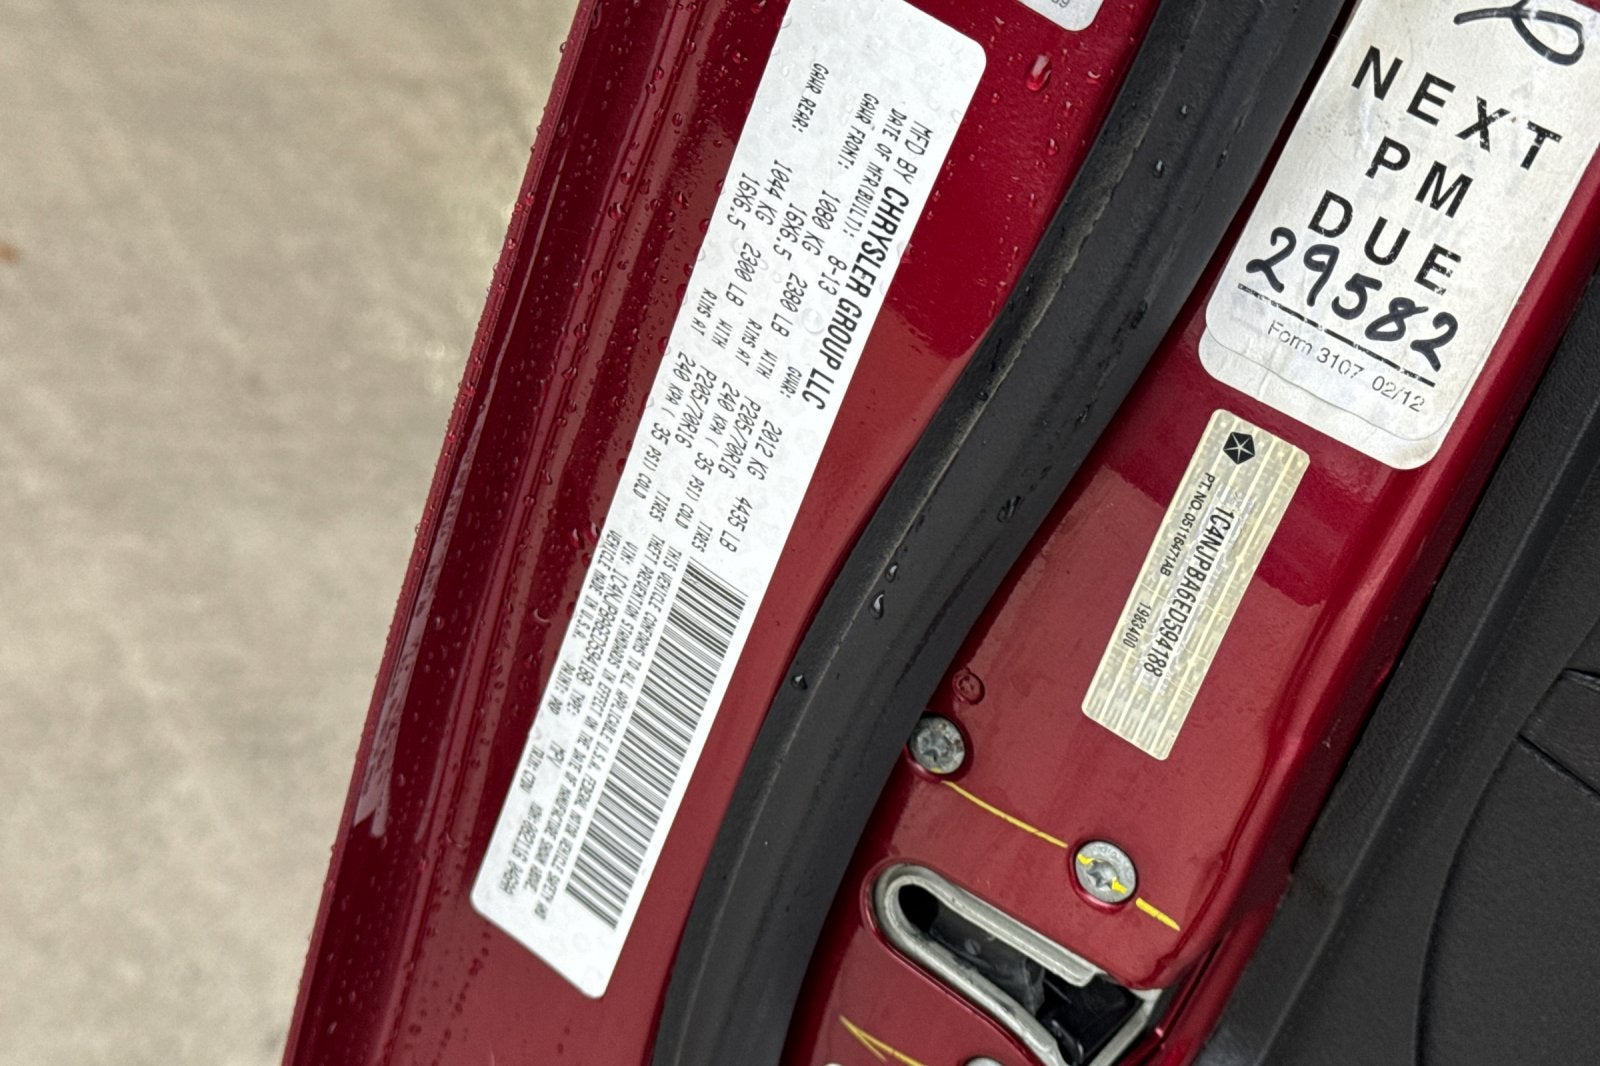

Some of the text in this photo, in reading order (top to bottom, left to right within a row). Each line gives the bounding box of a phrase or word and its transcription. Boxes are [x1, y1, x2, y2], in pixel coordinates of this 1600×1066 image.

[1351, 45, 1563, 171] NEXT
[1365, 136, 1474, 218] PM
[725, 171, 761, 231] 16X6.5
[816, 106, 908, 296] DATE OF MFR(BUILT): 8-13
[771, 201, 808, 261] 16X6.5
[1307, 189, 1462, 296] DUE
[800, 119, 934, 410] MFD BY CHRYSLER GROUP LLC
[648, 61, 830, 523] GAWR REAR: 1044 KG 2300 LB WITH P205/70R16 TIRES
[695, 286, 718, 319] RIMS
[1245, 227, 1459, 372] 29582
[689, 316, 707, 337] AT
[690, 92, 880, 553] GAWR FRONT: 1080 KG 2380 LB WITH P205/70R16 TIRES
[740, 317, 763, 349] RIMS
[671, 350, 697, 382] 240
[734, 346, 751, 367] AT
[1267, 320, 1426, 413] Form 3107 02/12
[664, 381, 684, 406] KPA
[715, 380, 741, 412] 240
[649, 421, 671, 446] 35
[708, 411, 728, 436] KPA
[641, 443, 662, 472] PSI)
[693, 451, 715, 476] 35
[718, 365, 803, 553] GVWR: 2012 KG 4435 LB
[631, 471, 652, 500] COLD
[684, 473, 705, 502] PSI)
[673, 501, 695, 530] COLD
[596, 528, 623, 572] VEHICLE
[619, 539, 639, 565] VIN:
[643, 533, 666, 566] THEFT
[661, 544, 683, 572] THIS
[1121, 471, 1216, 649] PT. NO. 05116471AB 1983400
[587, 568, 607, 596] MADE
[623, 562, 655, 621] PREVENTION
[646, 570, 673, 613] VEHICLE
[1142, 505, 1235, 678] 1C4NJPBA6ED594188
[582, 593, 599, 611] IN
[571, 607, 594, 639] U.S.A.
[631, 610, 658, 657] CONFORMS
[606, 617, 635, 670] STANDARDS
[600, 666, 617, 684] IN
[618, 668, 636, 688] ALL
[626, 655, 642, 671] TO
[565, 688, 586, 716] TYPE:
[589, 680, 612, 718] EFFECT
[583, 714, 599, 731] ON
[598, 687, 629, 744] APPLICABLE
[545, 740, 566, 769] MPV
[575, 730, 594, 751] THE
[586, 739, 609, 771] U.S.A.
